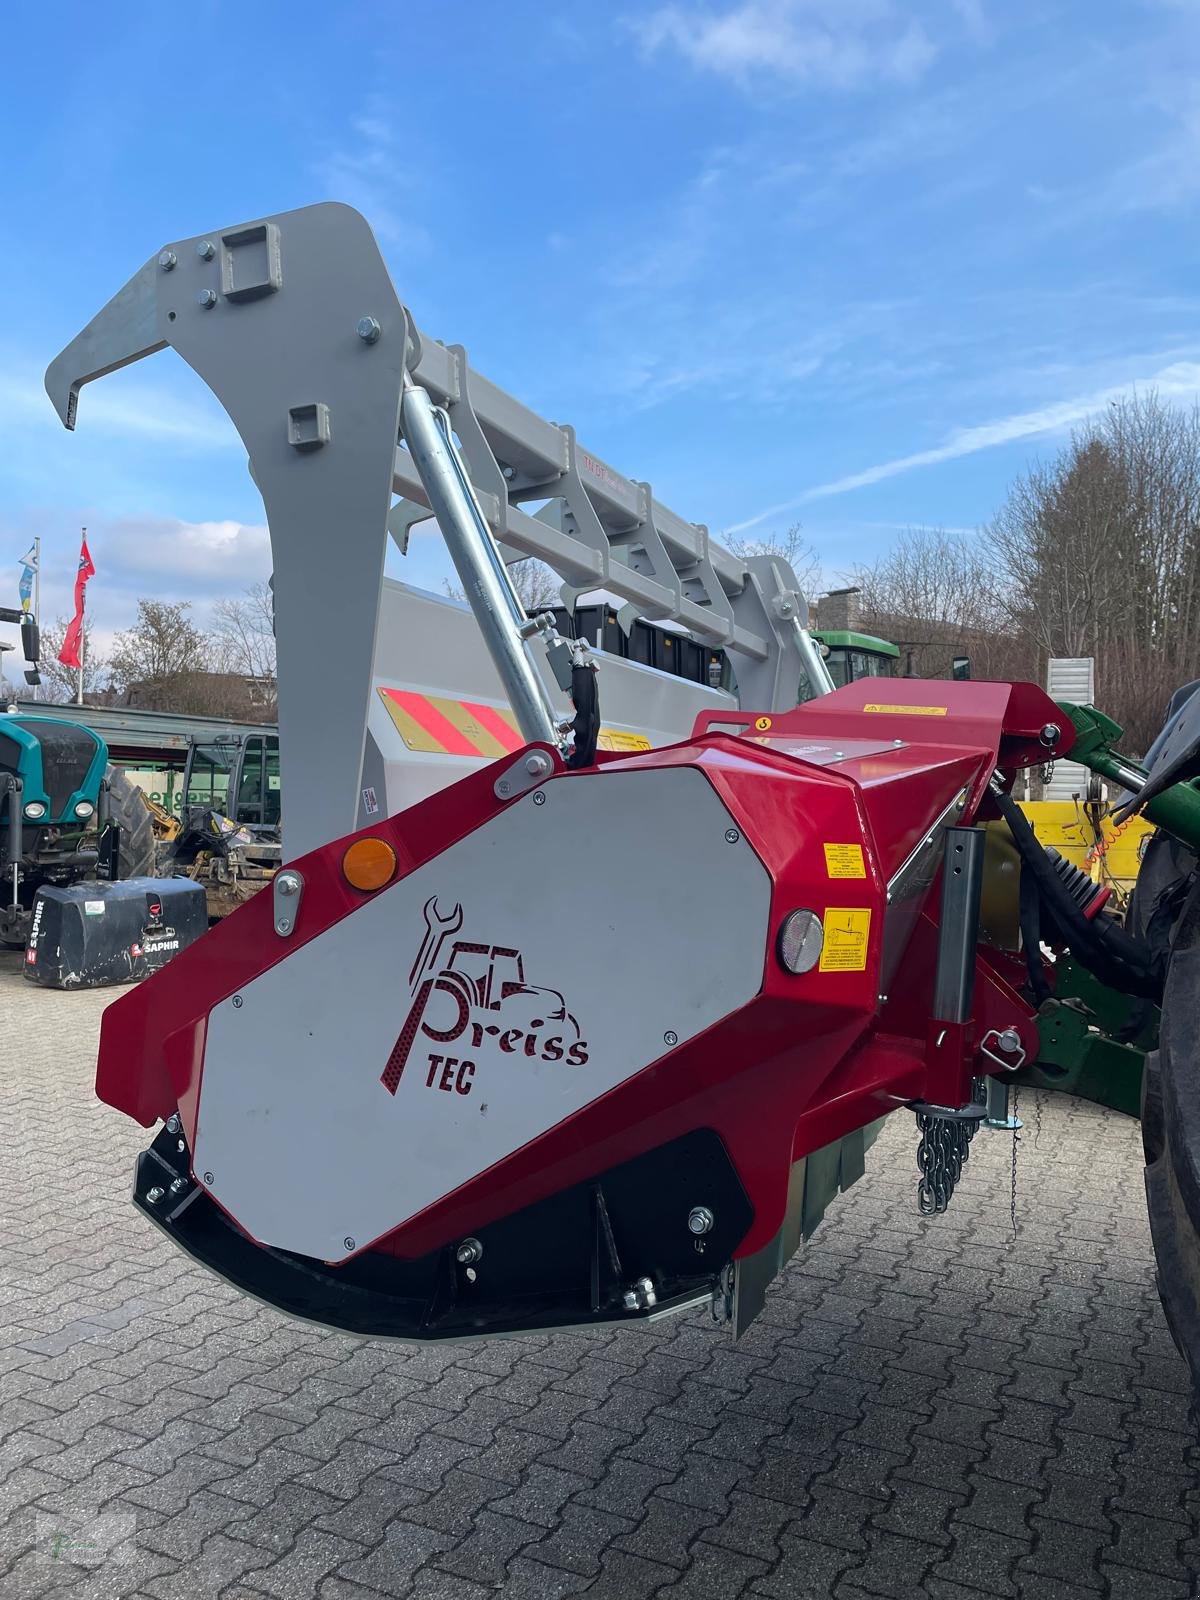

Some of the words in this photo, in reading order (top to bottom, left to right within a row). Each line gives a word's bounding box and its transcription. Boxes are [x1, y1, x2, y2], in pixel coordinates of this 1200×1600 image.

[30, 901, 44, 948] SAPHIR
[143, 940, 179, 953] SAPHIR
[379, 978, 589, 1097] Preiss
[425, 1053, 476, 1096] TEC
